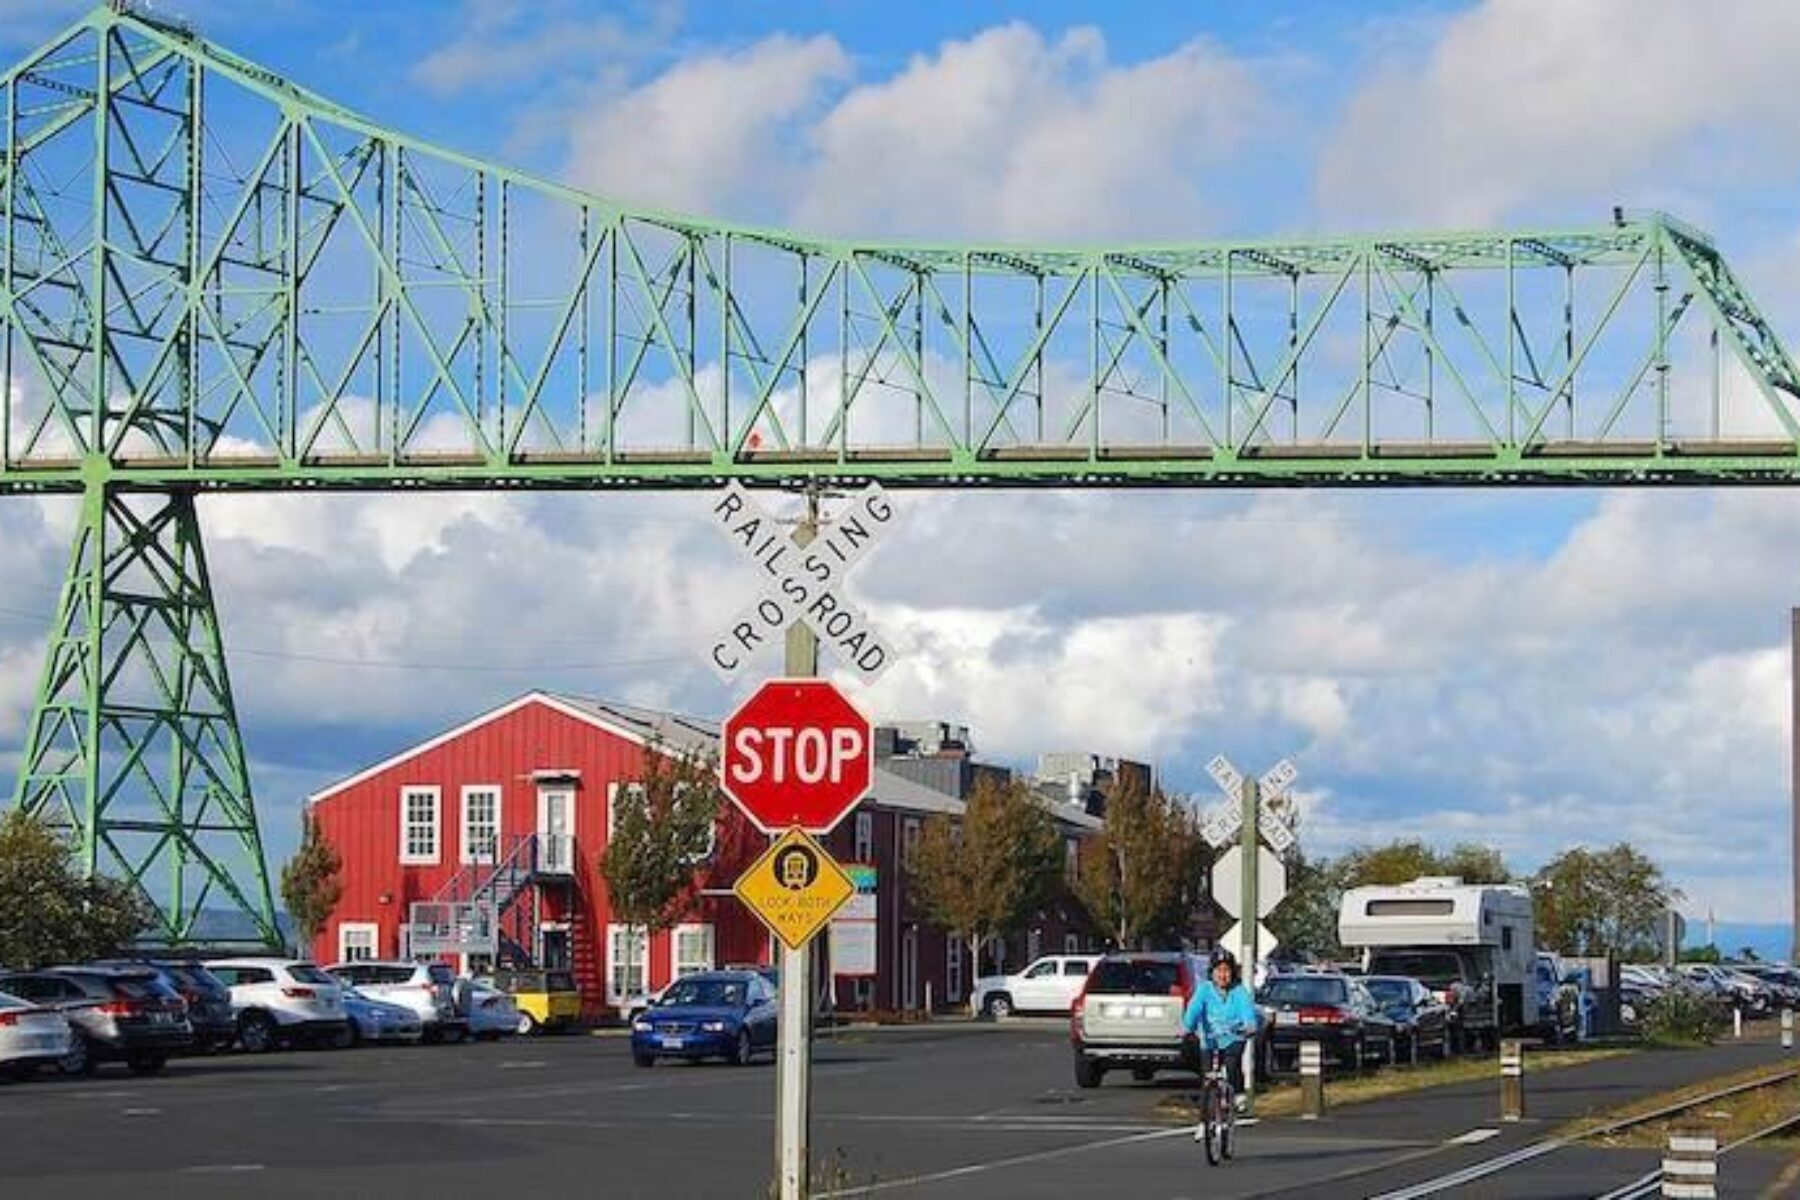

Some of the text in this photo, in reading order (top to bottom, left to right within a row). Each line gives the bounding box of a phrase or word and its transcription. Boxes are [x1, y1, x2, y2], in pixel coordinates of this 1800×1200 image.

[712, 495, 892, 671] CROSSING
[732, 726, 863, 784] STOP
[760, 896, 830, 908] LOOK BOTH
[777, 912, 814, 924] WAYS
